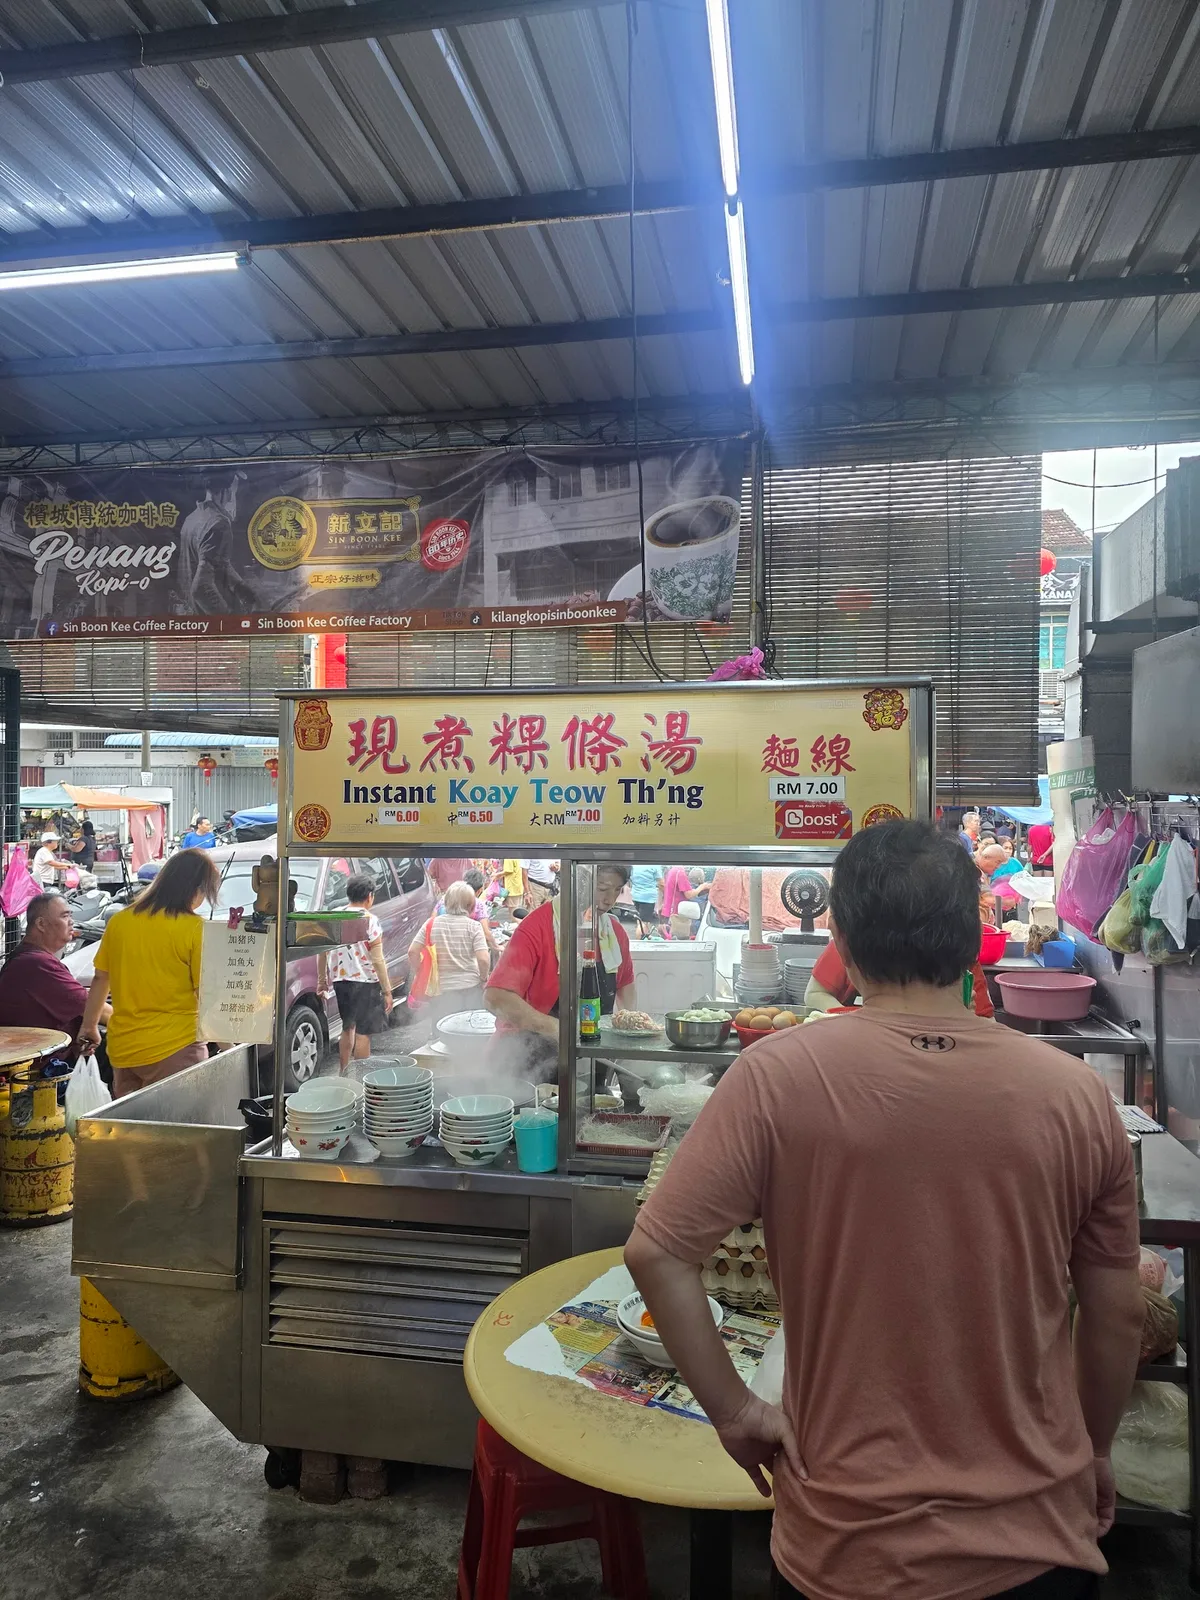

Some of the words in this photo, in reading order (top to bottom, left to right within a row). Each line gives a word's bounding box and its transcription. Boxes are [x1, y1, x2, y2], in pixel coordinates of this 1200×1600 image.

[25, 502, 178, 527] 檳城傳統咖啡烏
[327, 511, 403, 534] 新文記
[350, 535, 378, 543] BOON
[383, 534, 402, 542] KEE
[29, 530, 177, 579] Penang
[75, 570, 150, 596] Kopi-o
[311, 573, 379, 584] 正宗好滋味
[258, 618, 274, 629] Sin
[277, 617, 304, 628] Boon
[307, 617, 326, 627] Kee
[329, 616, 366, 627] Coffee
[369, 615, 412, 628] Factory
[491, 606, 617, 625] kilangkopisinboonkee
[63, 622, 78, 633] Sin
[81, 621, 108, 632] Boon
[111, 621, 131, 632] Kee
[132, 621, 166, 631] Coffee
[168, 620, 209, 633] Factory
[347, 710, 703, 776] 現煮粿條湯
[760, 733, 857, 777] 麵線
[343, 778, 437, 804] Instant
[449, 778, 519, 809] Koay
[529, 778, 607, 804] Teow
[617, 778, 704, 809] Th'ng
[777, 782, 801, 795] RM
[806, 782, 838, 795] 7.00
[447, 812, 458, 826] 中
[622, 812, 681, 827] 加料另计
[786, 810, 838, 828] Boost
[228, 934, 256, 945] 加猪肉
[227, 957, 254, 967] 加鱼丸
[226, 979, 253, 990] 加鸡蛋
